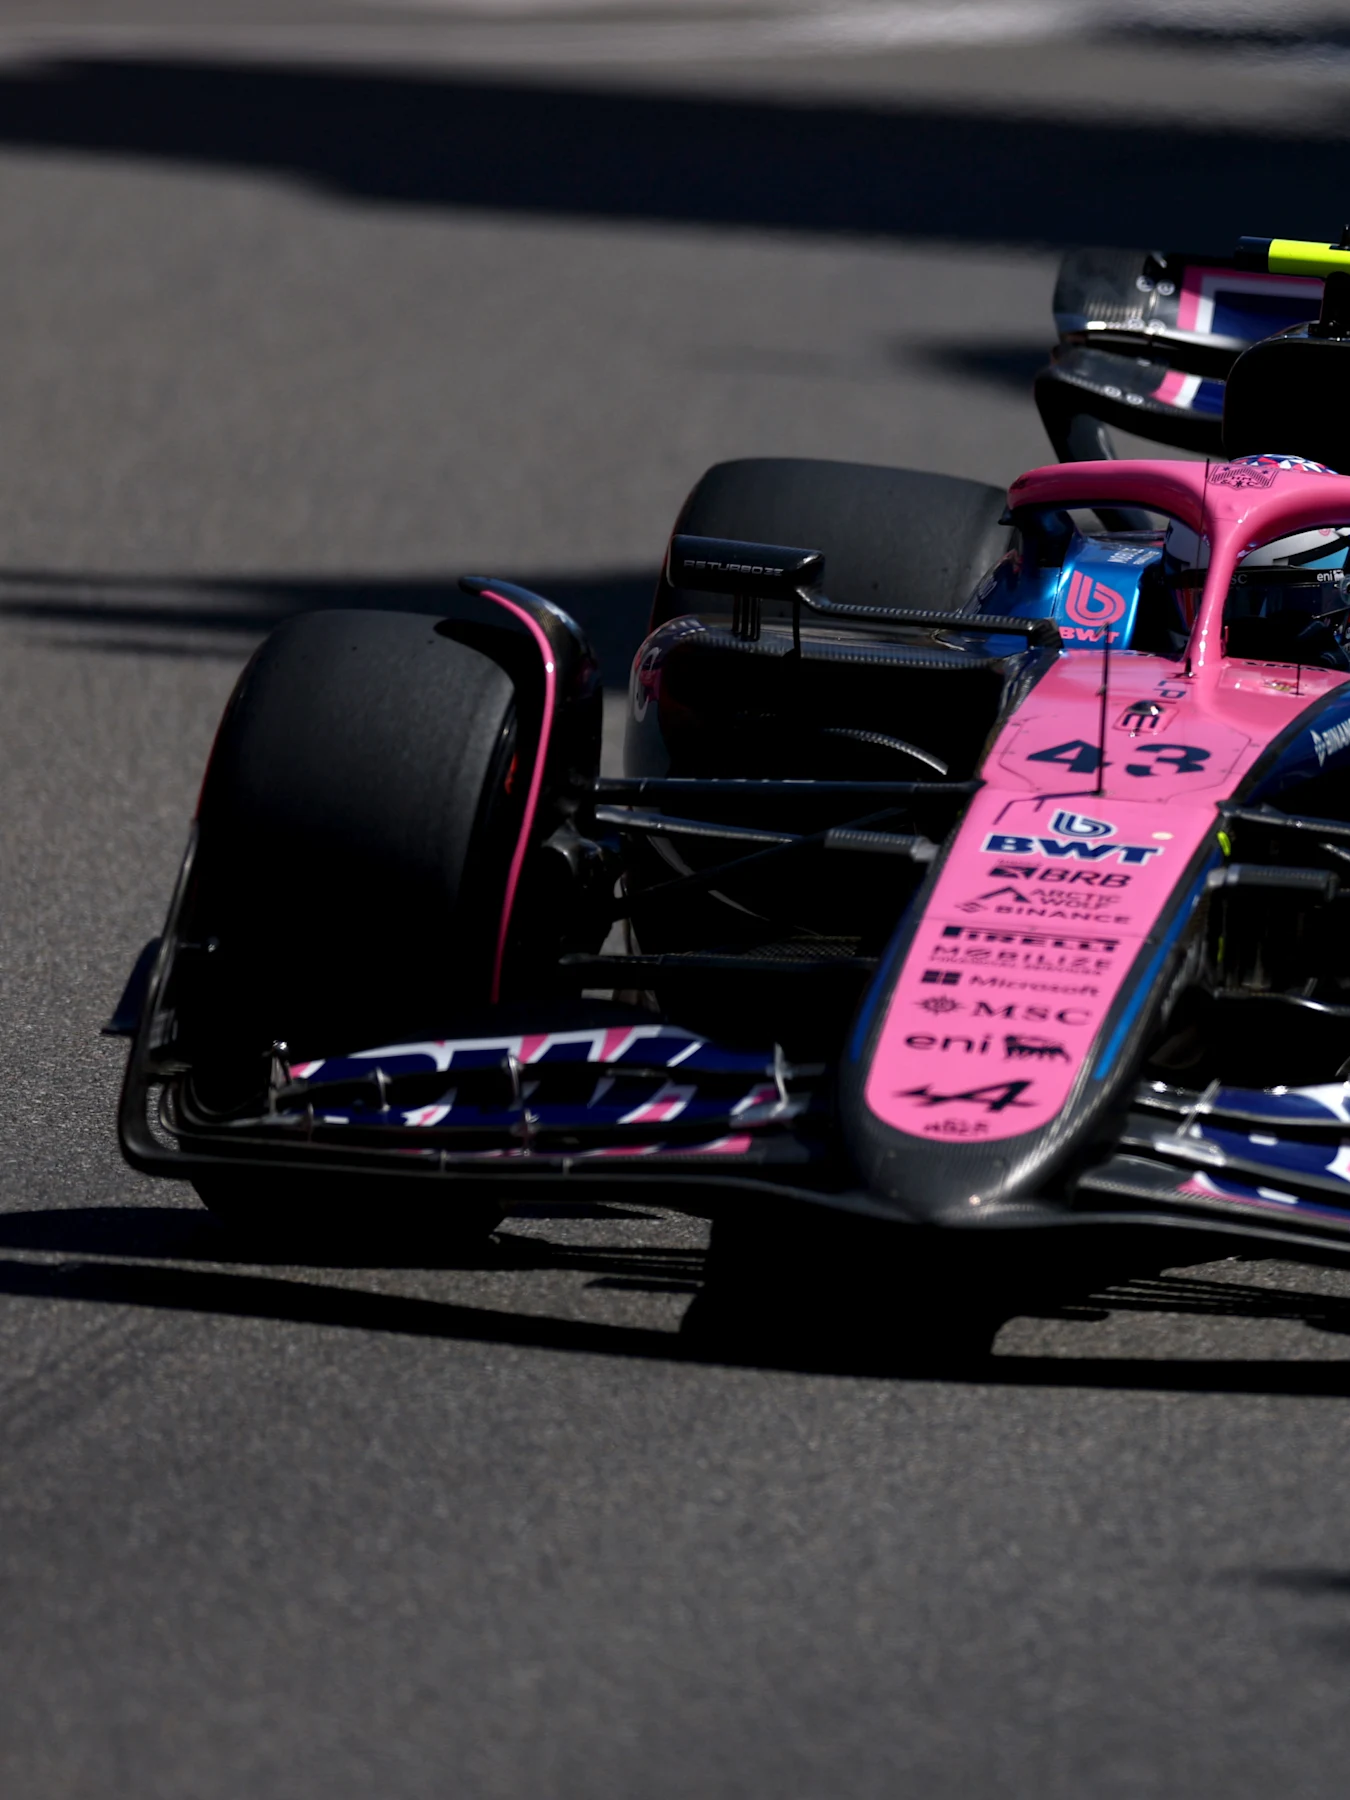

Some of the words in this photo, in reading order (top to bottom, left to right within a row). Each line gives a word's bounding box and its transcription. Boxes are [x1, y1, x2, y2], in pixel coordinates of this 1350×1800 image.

[1316, 570, 1334, 582] eni
[1058, 626, 1121, 644] BWT
[1027, 739, 1212, 777] 43
[983, 833, 1161, 866] BWT
[1038, 867, 1132, 888] BRB
[1029, 888, 1123, 904] ARCTIC
[1040, 897, 1115, 910] WOLF
[994, 905, 1132, 924] BINANCE
[942, 925, 1120, 952] PIRELLI
[968, 975, 1100, 997] Microsoft
[972, 1001, 1092, 1026] MSC
[906, 1034, 991, 1054] eni
